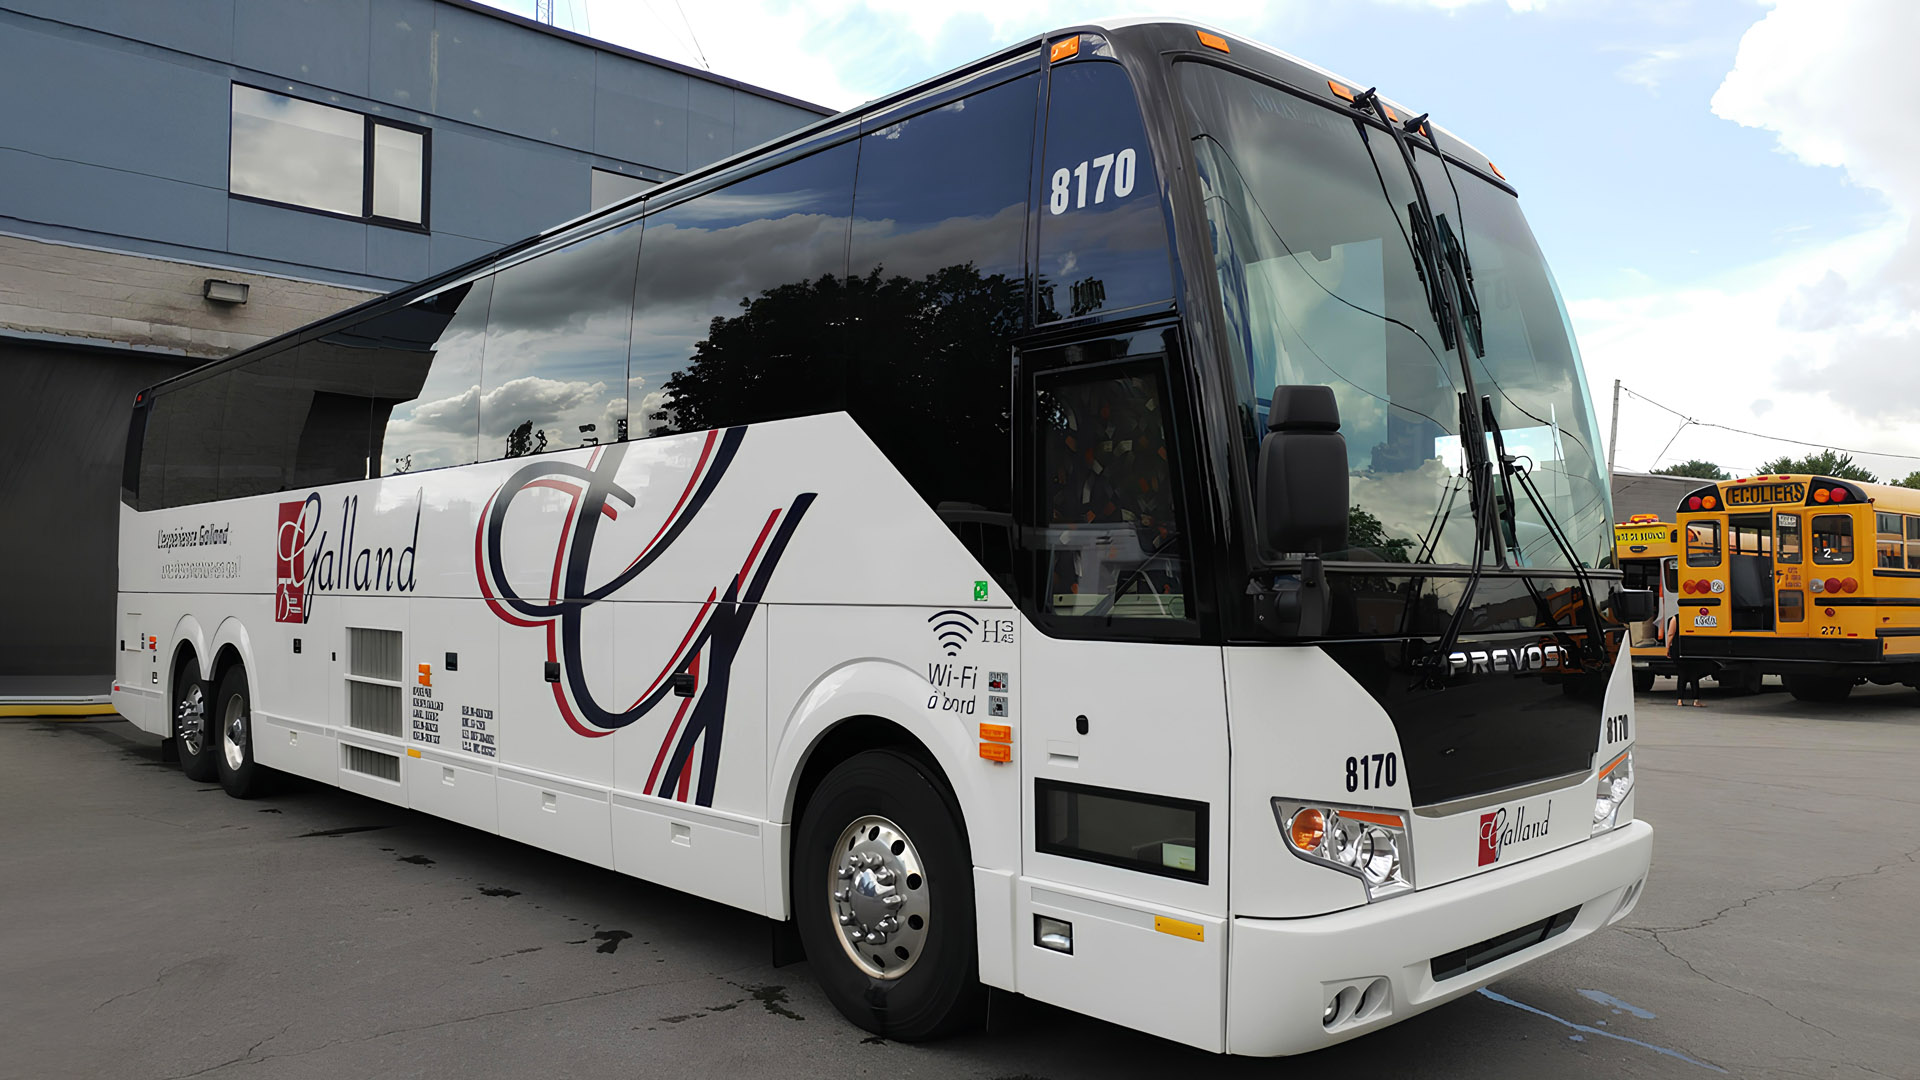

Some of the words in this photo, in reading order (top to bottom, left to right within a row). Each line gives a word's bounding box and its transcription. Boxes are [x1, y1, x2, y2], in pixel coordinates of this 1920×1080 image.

[1050, 148, 1136, 216] 8170
[1732, 484, 1805, 504] ECOLIERS
[278, 487, 423, 624] Galland
[1821, 626, 1842, 635] 271
[928, 663, 978, 689] Wi-Fi
[942, 692, 976, 715] bord
[1607, 714, 1628, 744] 8170
[1346, 752, 1397, 792] 8170
[1480, 799, 1552, 862] Galland
